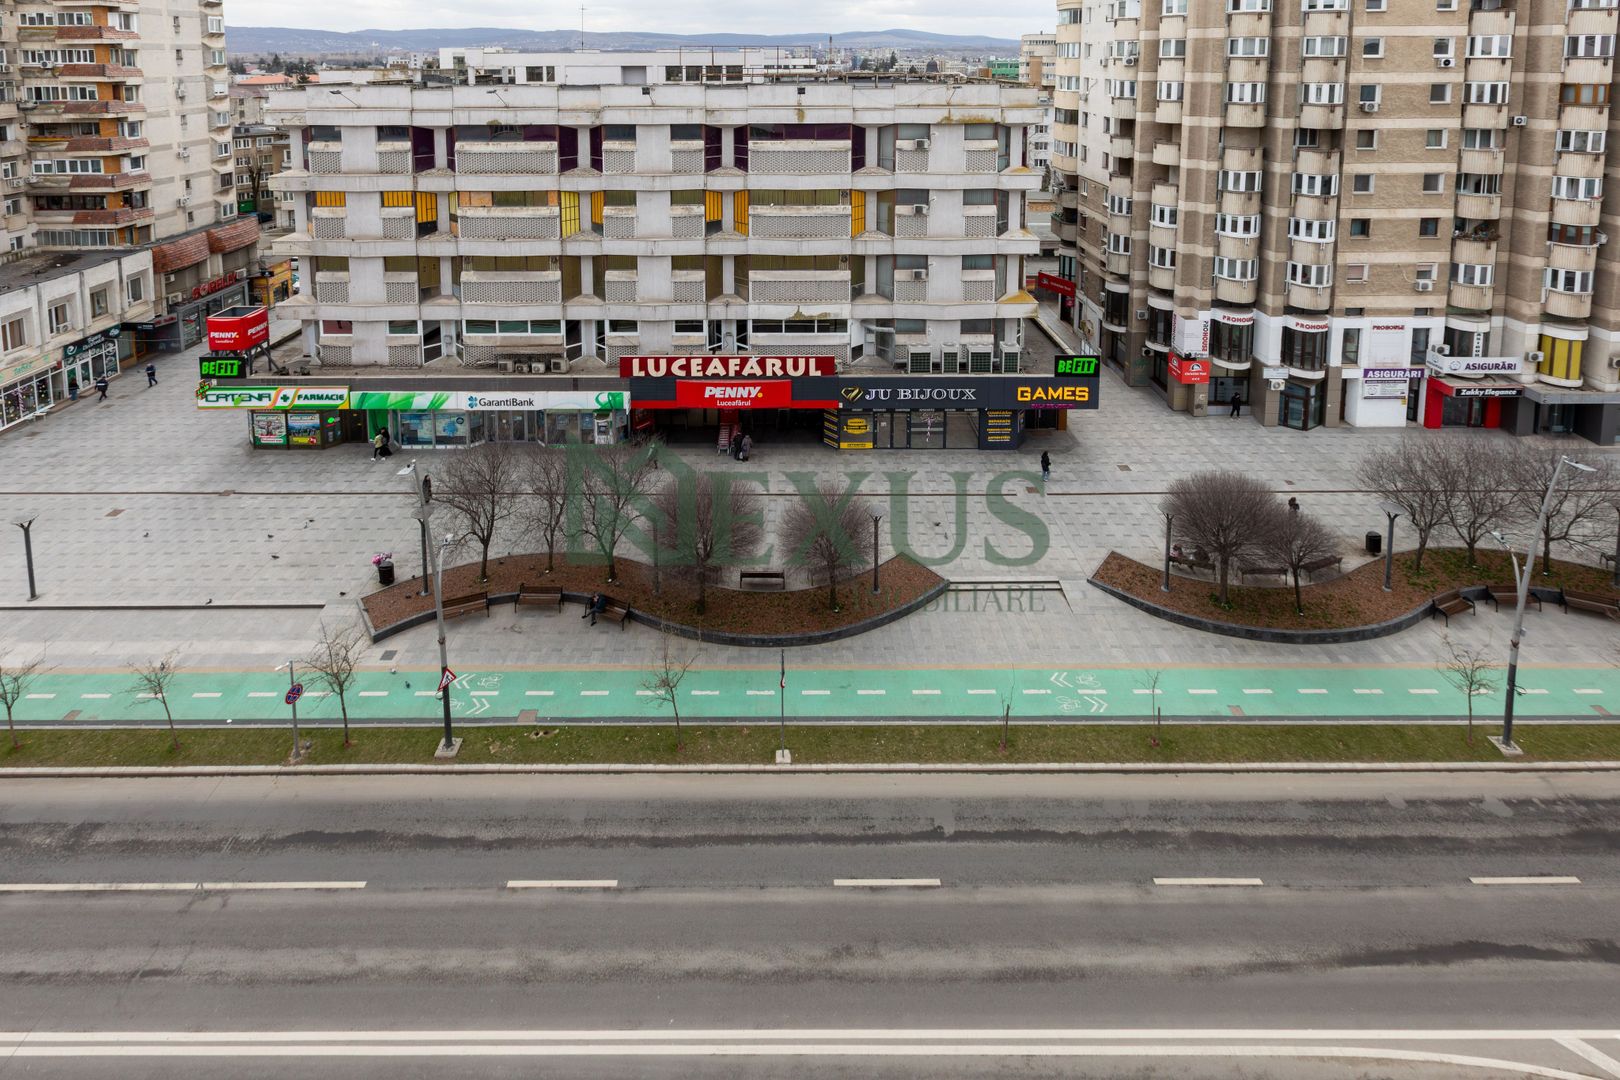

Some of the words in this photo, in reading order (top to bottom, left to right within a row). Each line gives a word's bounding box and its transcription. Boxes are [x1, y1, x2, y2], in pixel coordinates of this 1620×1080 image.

[632, 356, 822, 377] LUCEAFĂRUL
[1465, 361, 1517, 370] ASIGURĂRI
[205, 392, 271, 403] CATENA
[297, 394, 345, 402] FARMACIE
[865, 389, 892, 401] JU
[896, 388, 977, 401] BIJOUX
[1017, 386, 1089, 401] GAMES
[1460, 389, 1484, 397] Zakky
[1484, 389, 1517, 397] Elegance
[478, 397, 534, 407] GarantiBank
